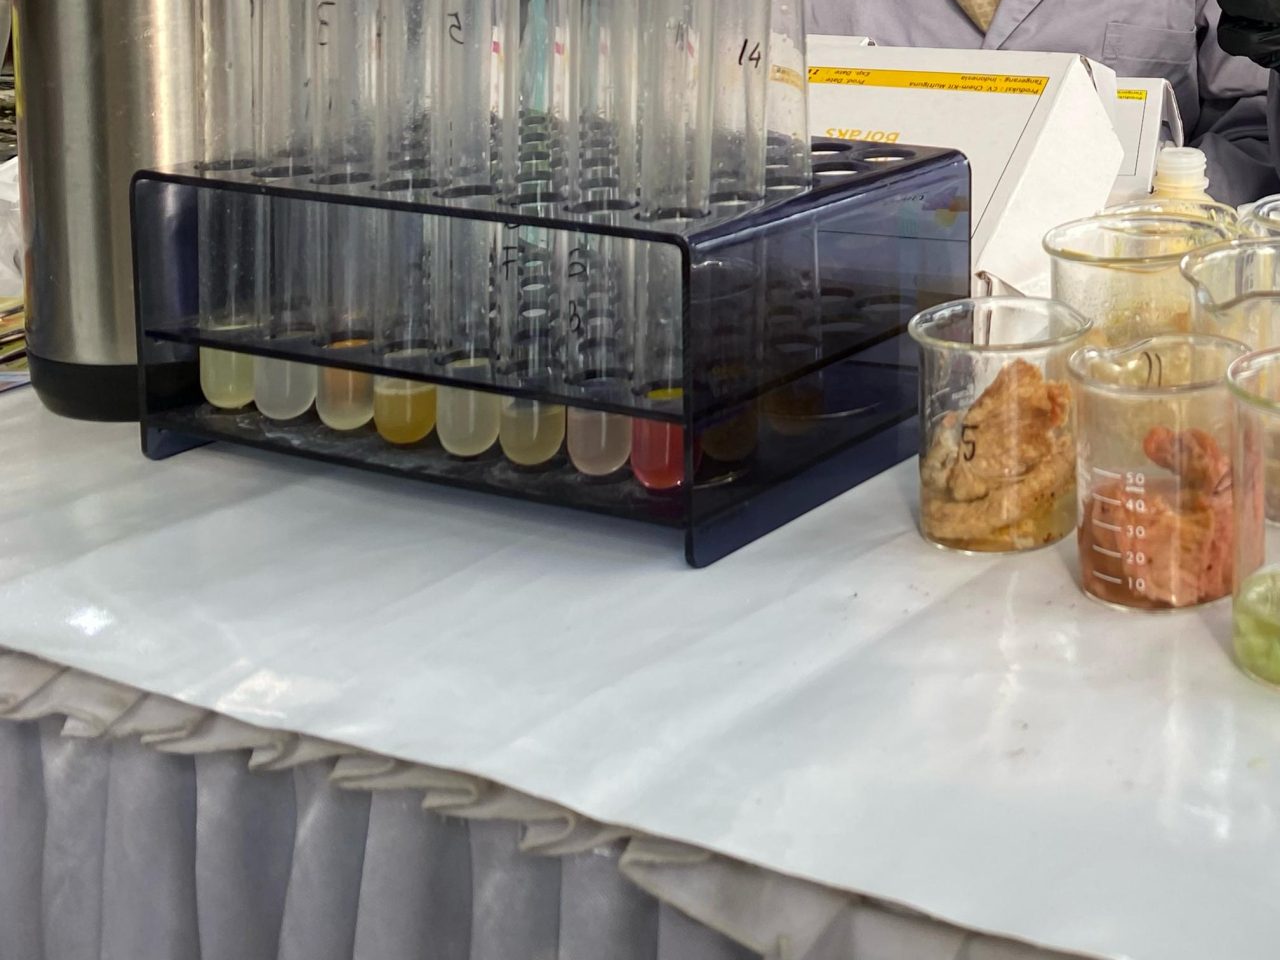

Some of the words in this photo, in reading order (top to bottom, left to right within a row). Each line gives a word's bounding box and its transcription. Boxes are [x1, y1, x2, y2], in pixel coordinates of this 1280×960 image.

[738, 38, 762, 68] 14
[1004, 76, 1042, 85] Tangerang
[961, 424, 979, 462] 5
[1126, 471, 1146, 485] 50
[1126, 499, 1146, 513] 40
[1126, 525, 1146, 539] 30
[1126, 551, 1146, 565] 20
[1128, 576, 1146, 592] 10
